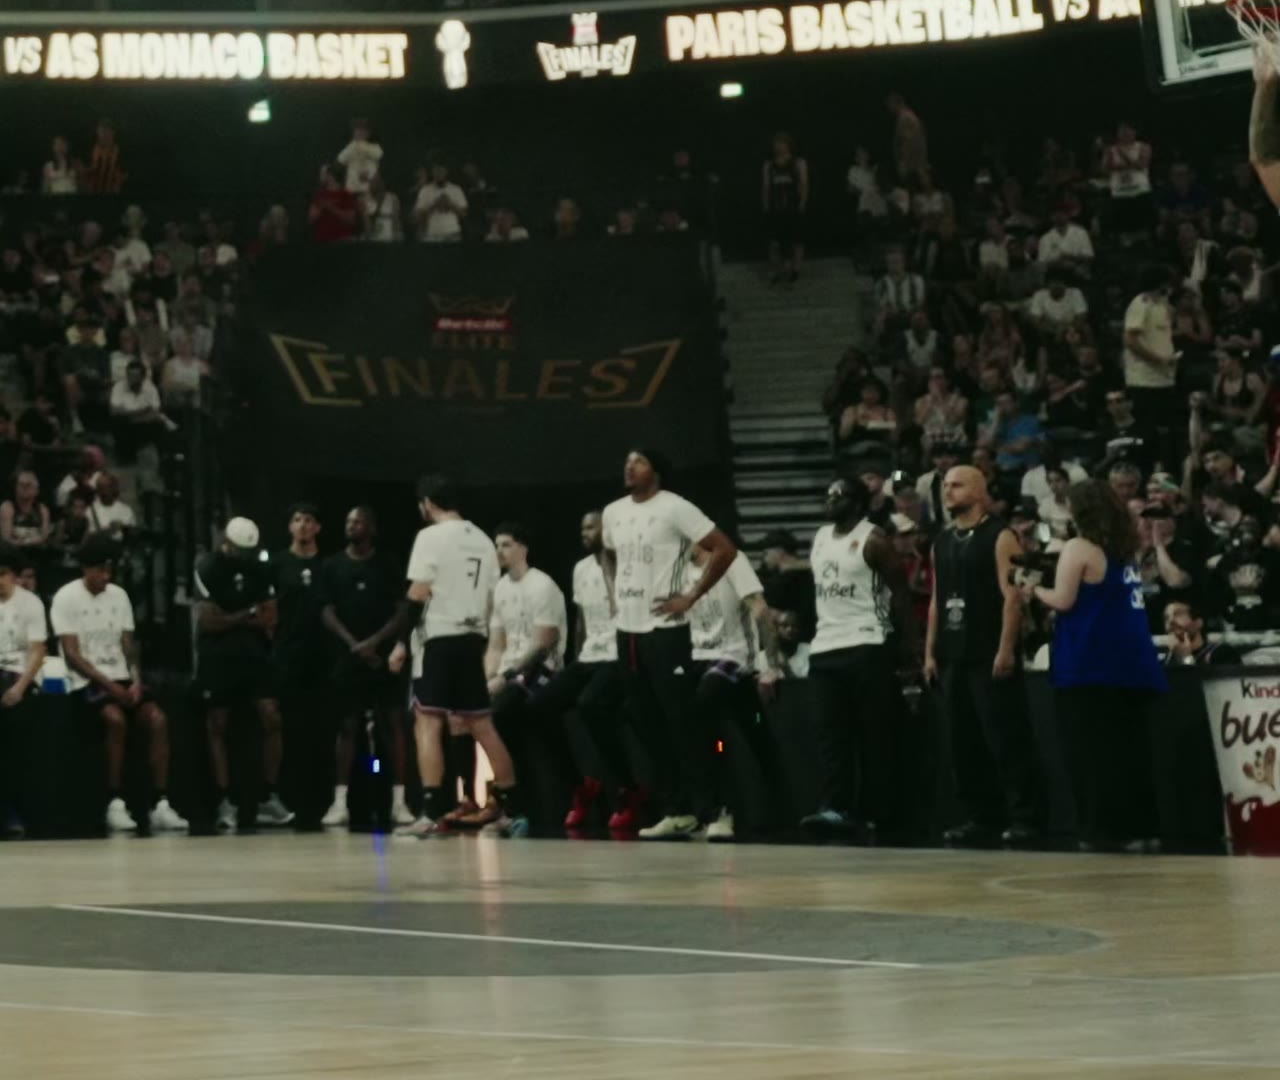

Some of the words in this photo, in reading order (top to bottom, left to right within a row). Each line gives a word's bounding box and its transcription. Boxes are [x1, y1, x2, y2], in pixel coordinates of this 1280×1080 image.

[4, 37, 42, 73] VS
[45, 32, 100, 79] AS
[101, 32, 265, 80] MONACO
[266, 33, 408, 79] BASKET
[666, 8, 786, 60] PARIS
[305, 352, 639, 401] FINALES
